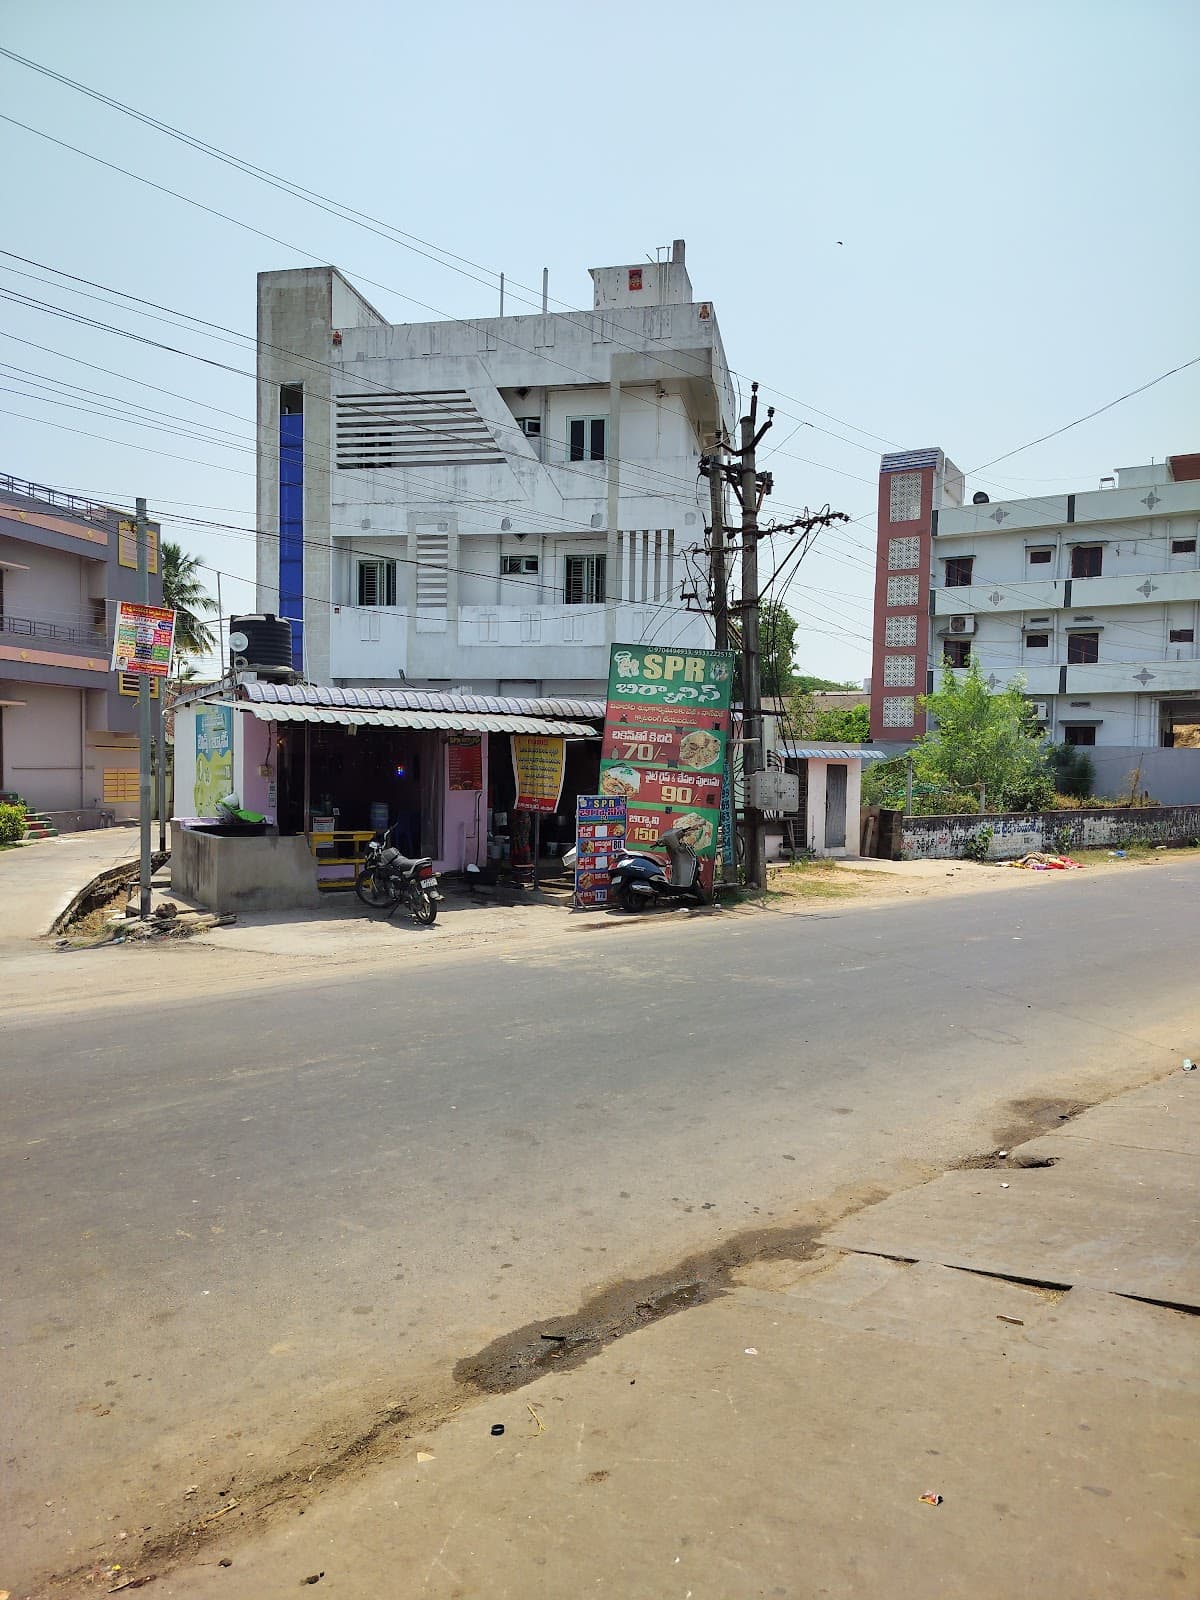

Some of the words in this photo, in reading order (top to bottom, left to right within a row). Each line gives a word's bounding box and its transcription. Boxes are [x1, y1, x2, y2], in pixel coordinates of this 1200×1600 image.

[643, 654, 706, 683] SPR
[622, 742, 668, 762] 70/-
[660, 785, 702, 804] 90/-
